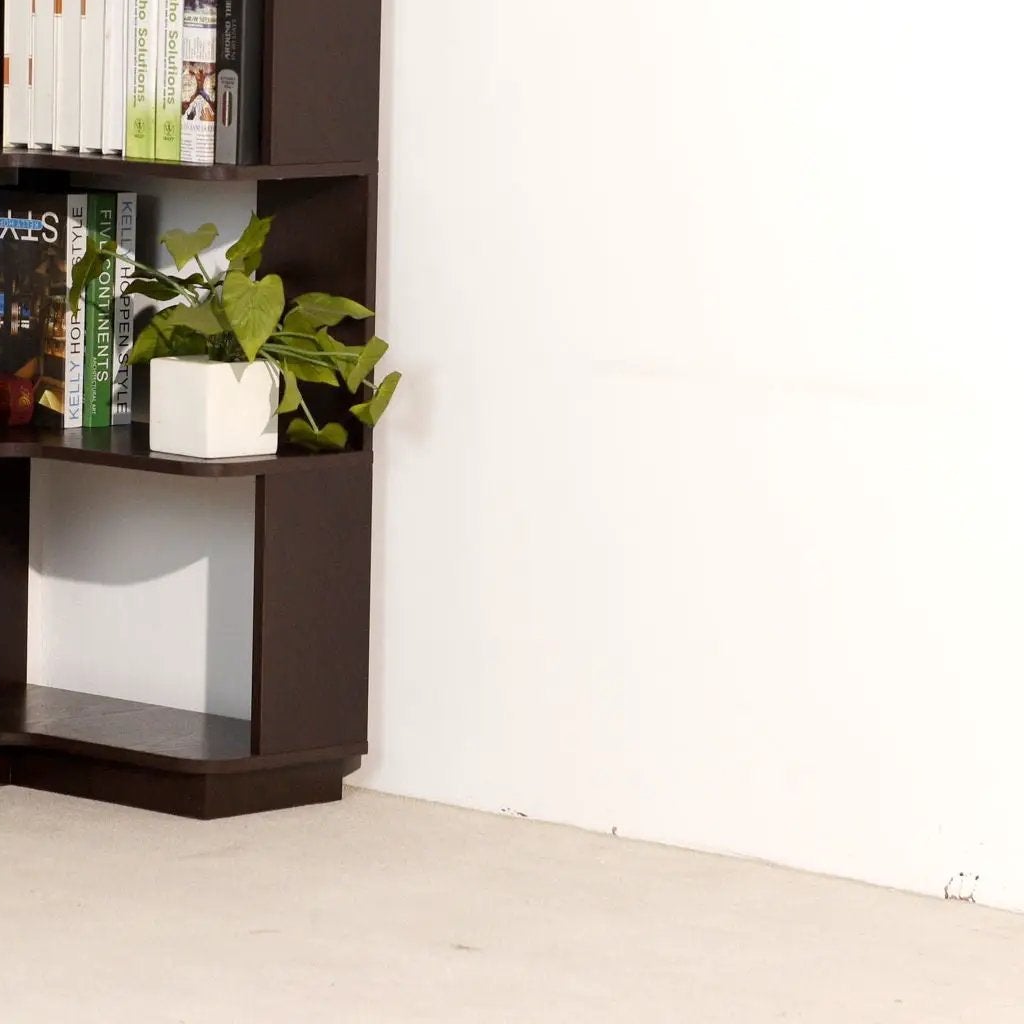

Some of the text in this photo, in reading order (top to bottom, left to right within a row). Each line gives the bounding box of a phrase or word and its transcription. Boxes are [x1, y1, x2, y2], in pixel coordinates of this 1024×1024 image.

[137, 28, 148, 102] Solutions
[167, 30, 179, 105] Solutions
[71, 207, 83, 266] STYLE
[68, 361, 81, 420] KELLY
[117, 353, 129, 413] STYLE
